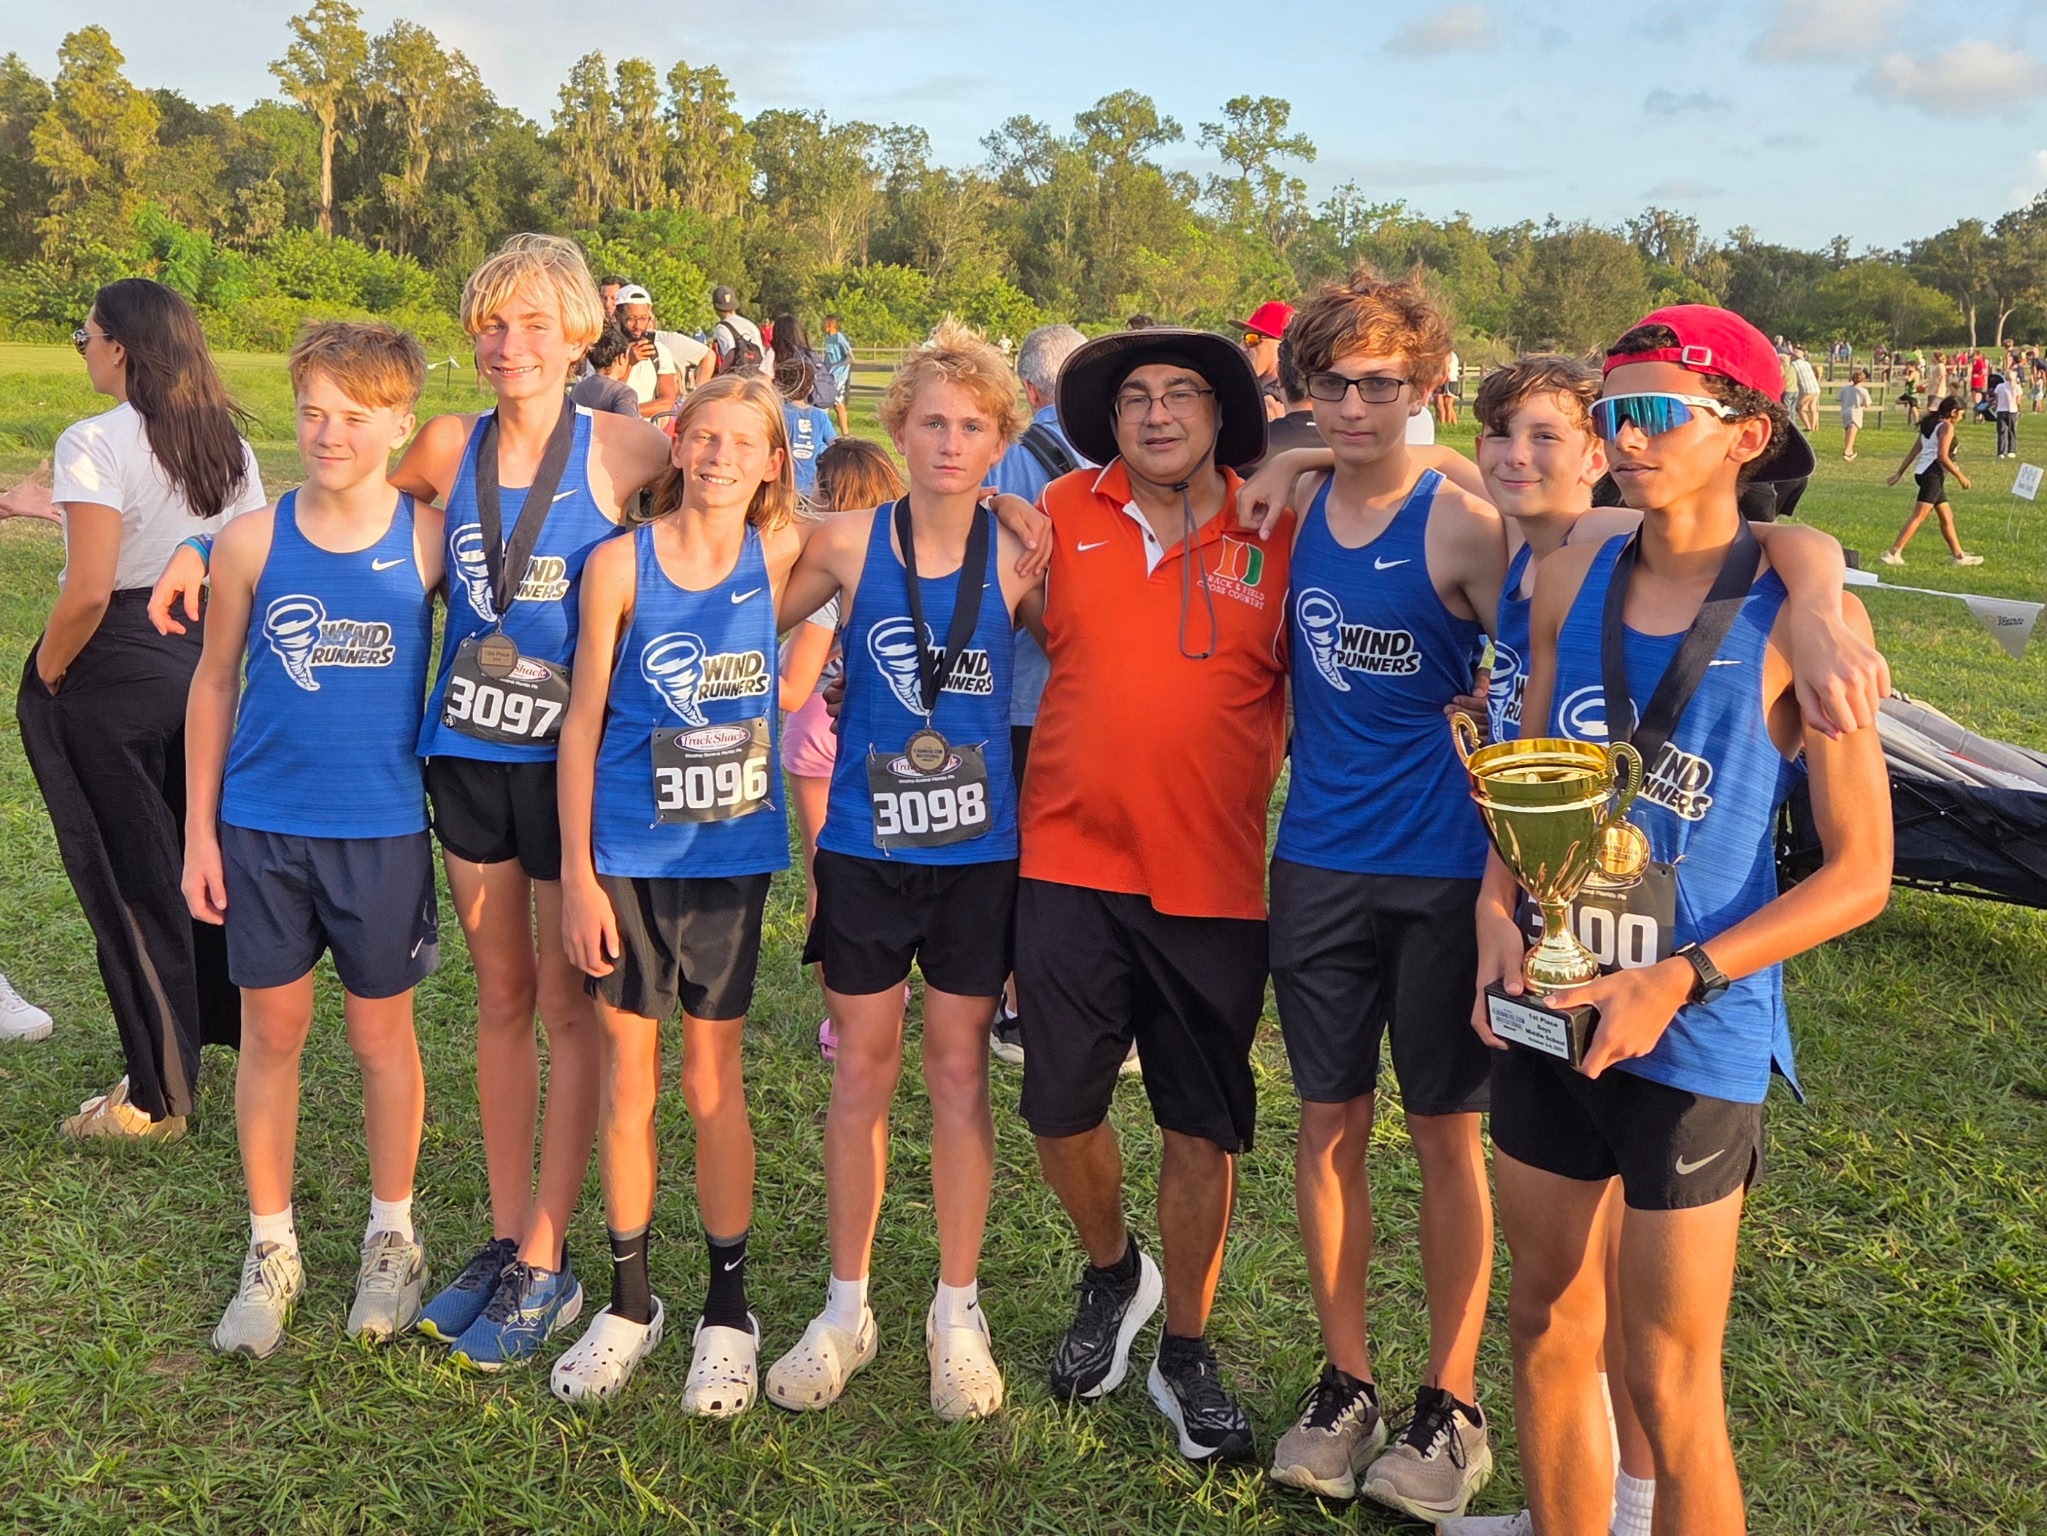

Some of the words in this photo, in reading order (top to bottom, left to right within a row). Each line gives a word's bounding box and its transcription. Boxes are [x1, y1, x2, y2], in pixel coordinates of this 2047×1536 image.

[527, 559, 565, 583] ND
[517, 581, 568, 599] NERS
[1205, 574, 1234, 588] RACK
[1243, 586, 1265, 601] FIELD
[1228, 589, 1265, 611] COUNTRY
[320, 621, 389, 648] WIND
[1340, 626, 1411, 657] WIND
[311, 647, 394, 664] RUNNERS
[703, 652, 762, 682] WIND
[1337, 650, 1419, 673] RUNNERS
[698, 675, 768, 700] RUNNERS
[942, 675, 992, 693] NNERS
[447, 676, 563, 737] 3097
[684, 735, 712, 746] Track
[713, 730, 747, 744] Shack
[1650, 744, 1711, 791] IND
[656, 756, 767, 809] 3096
[873, 782, 986, 835] 3098
[1641, 775, 1710, 818] NNERS
[1528, 1013, 1539, 1021] 1st
[1541, 1017, 1558, 1027] Place
[1537, 1024, 1551, 1034] Boys
[1525, 1028, 1544, 1039] Middle
[1545, 1035, 1565, 1046] School
